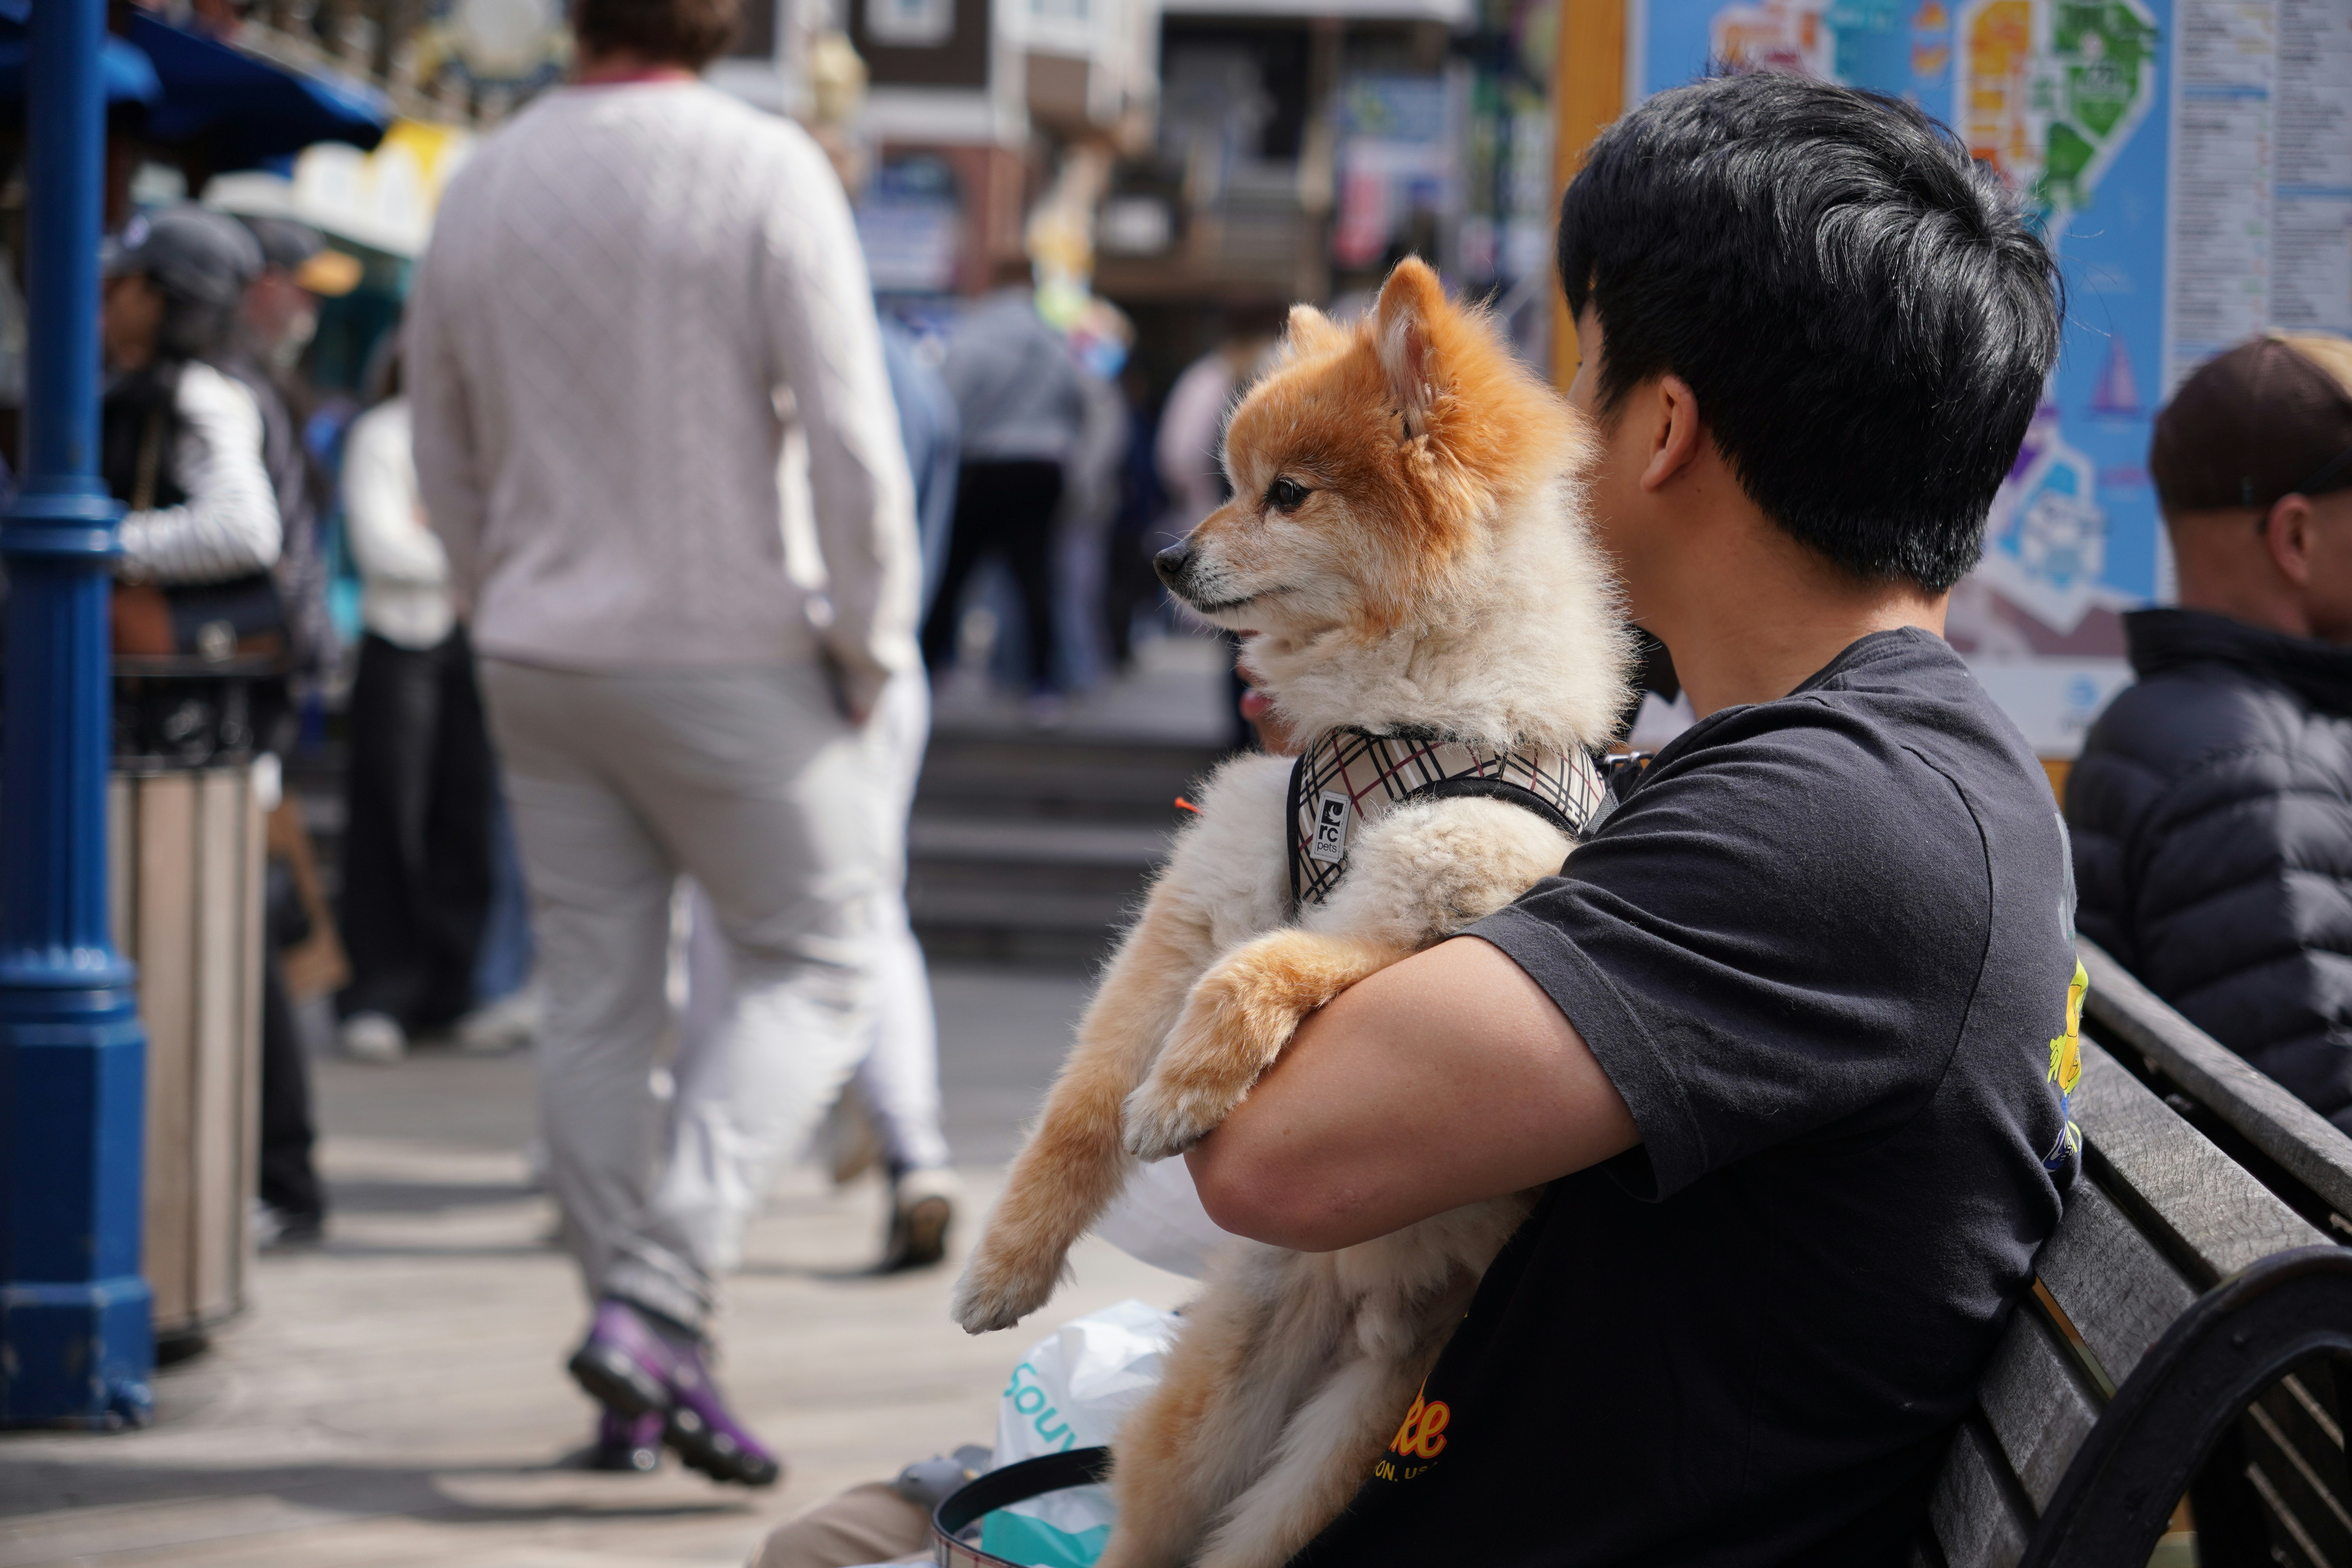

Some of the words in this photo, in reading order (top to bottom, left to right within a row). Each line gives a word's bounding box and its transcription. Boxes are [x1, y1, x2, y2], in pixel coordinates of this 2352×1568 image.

[1318, 824, 1339, 843] rc
[1317, 842, 1337, 853] pets
[1374, 1459, 1399, 1483] ON.
[1404, 1461, 1438, 1480] US
